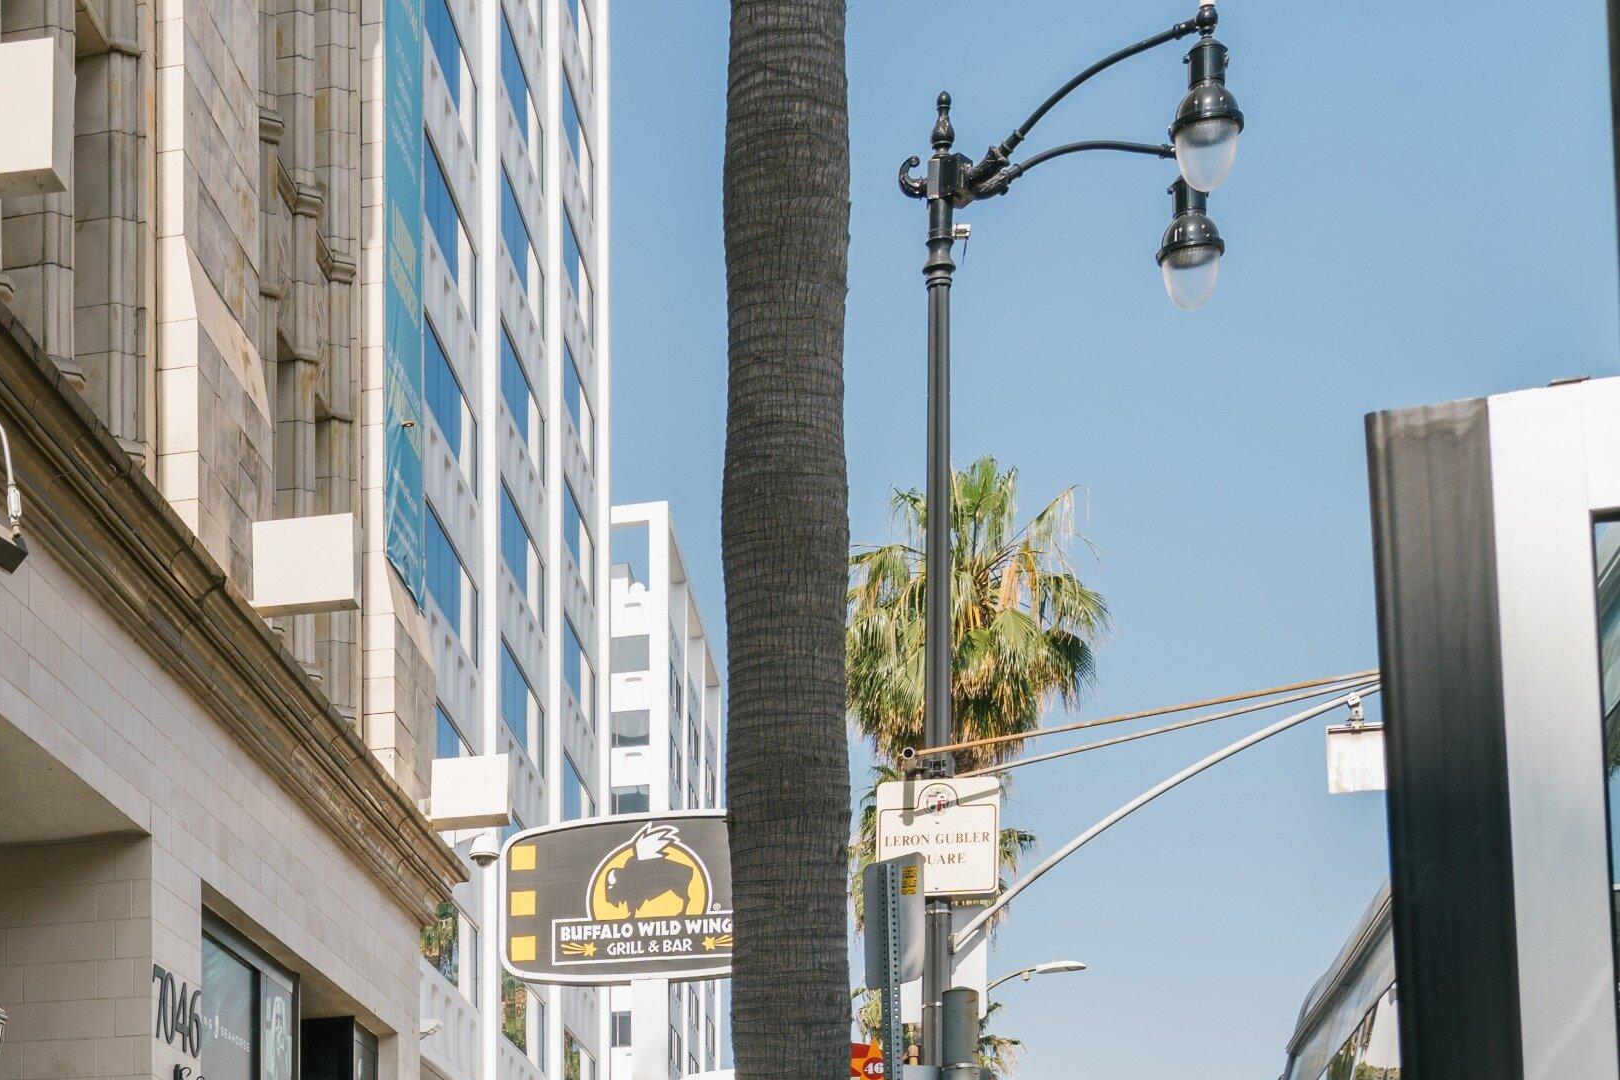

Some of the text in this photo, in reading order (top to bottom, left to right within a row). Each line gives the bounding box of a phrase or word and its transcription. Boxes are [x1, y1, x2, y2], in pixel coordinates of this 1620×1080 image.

[884, 831, 990, 847] LERON GUBLER
[924, 852, 966, 866] UARE
[560, 917, 732, 942] BUFFALO WILD WING
[606, 938, 693, 956] GRILL & BAR
[152, 963, 202, 1060] 7046
